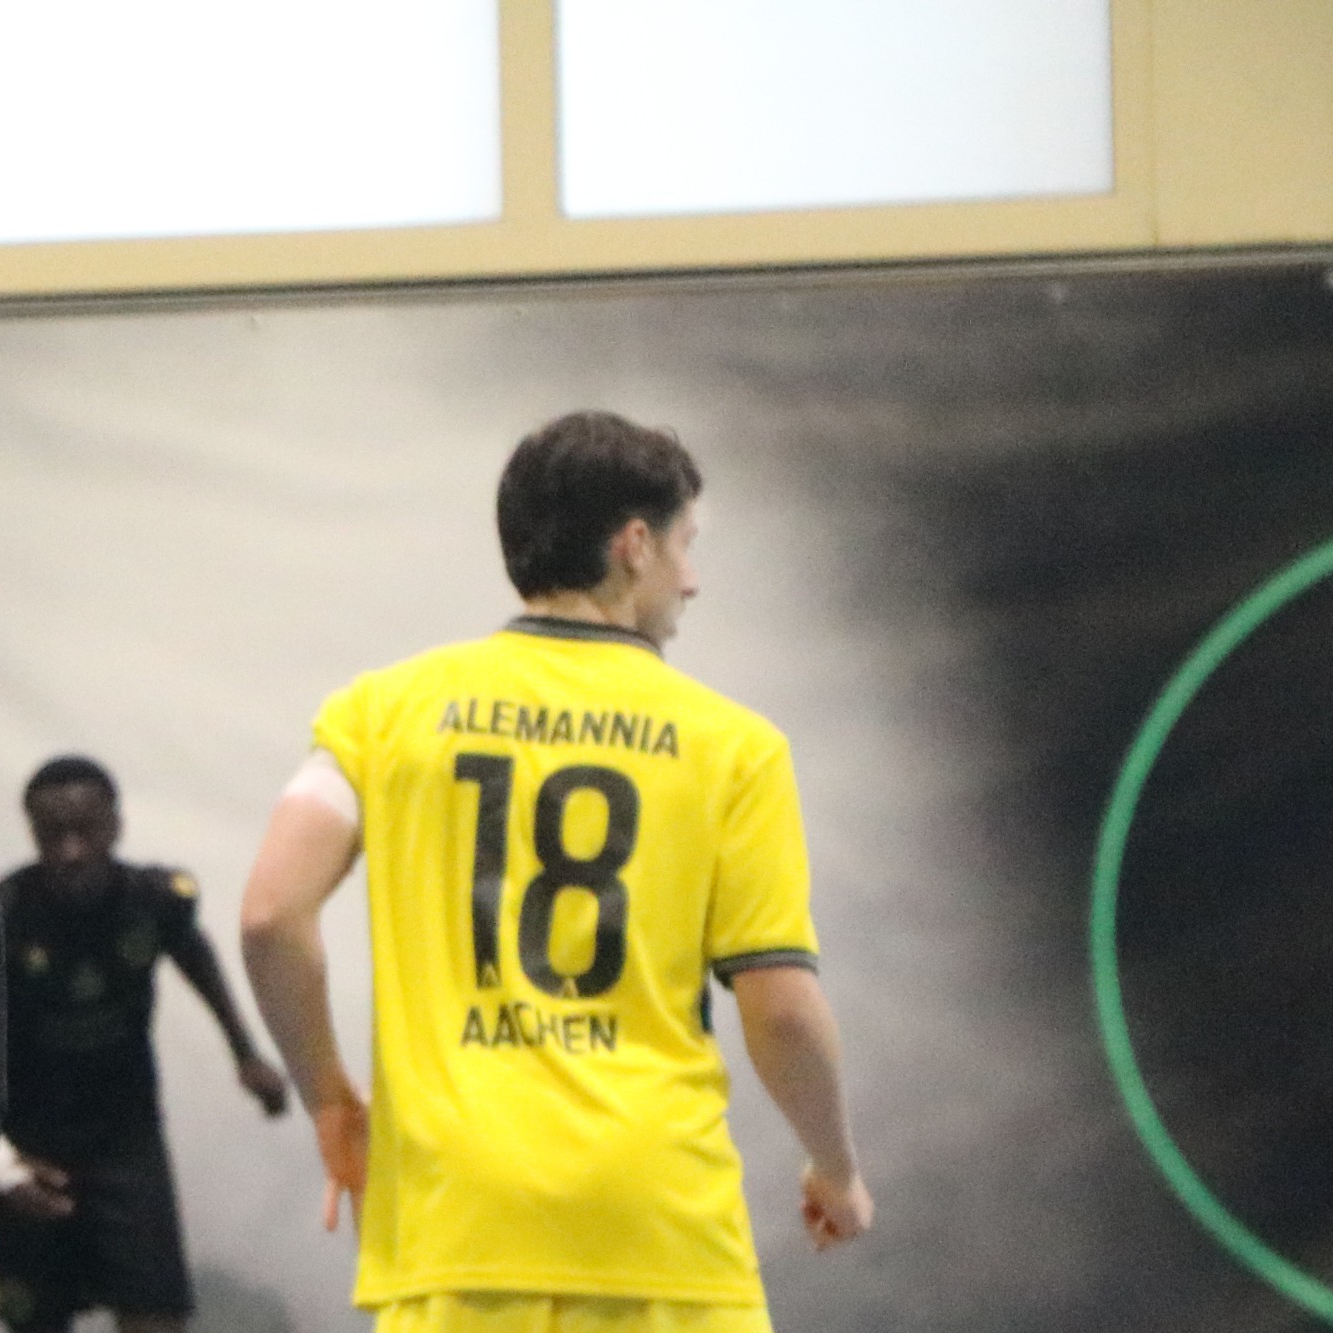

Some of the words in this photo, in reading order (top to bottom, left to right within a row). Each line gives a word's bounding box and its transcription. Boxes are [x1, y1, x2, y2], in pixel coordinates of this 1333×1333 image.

[439, 699, 679, 758] ALEMANNIA
[454, 753, 641, 999] 18
[462, 1002, 617, 1055] AACHEN
